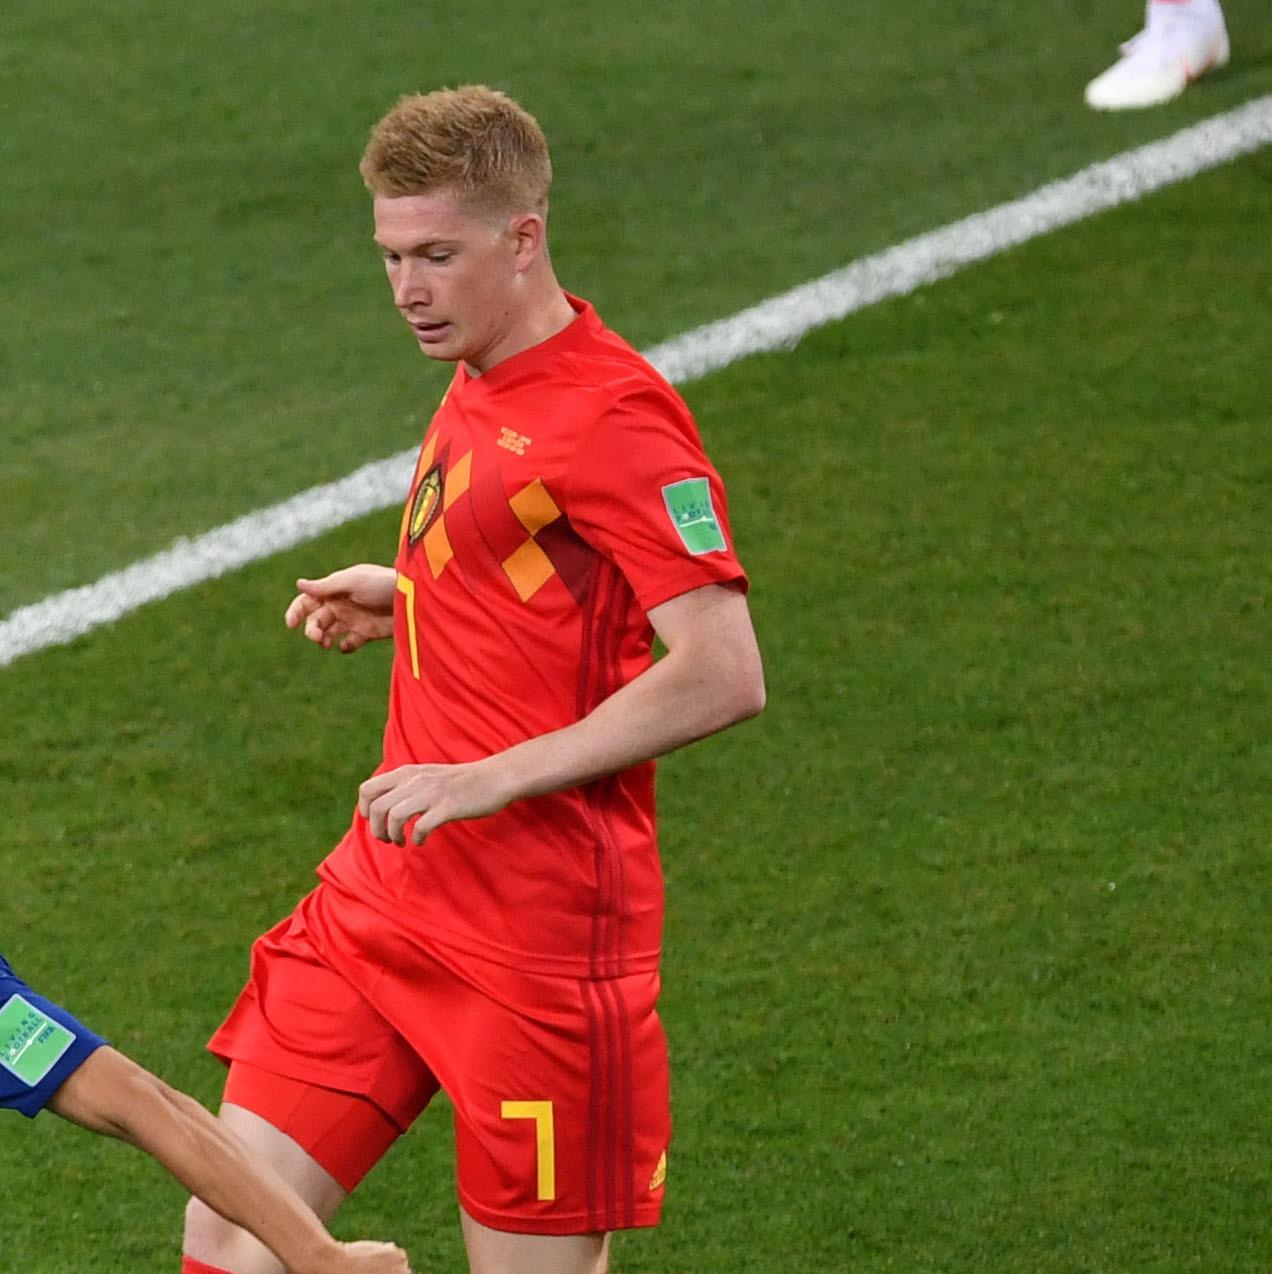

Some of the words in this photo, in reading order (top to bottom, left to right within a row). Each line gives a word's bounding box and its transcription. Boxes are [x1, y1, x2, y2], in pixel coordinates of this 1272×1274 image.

[397, 572, 420, 680] 7
[38, 1026, 55, 1044] FIFA
[501, 1101, 554, 1200] 7
